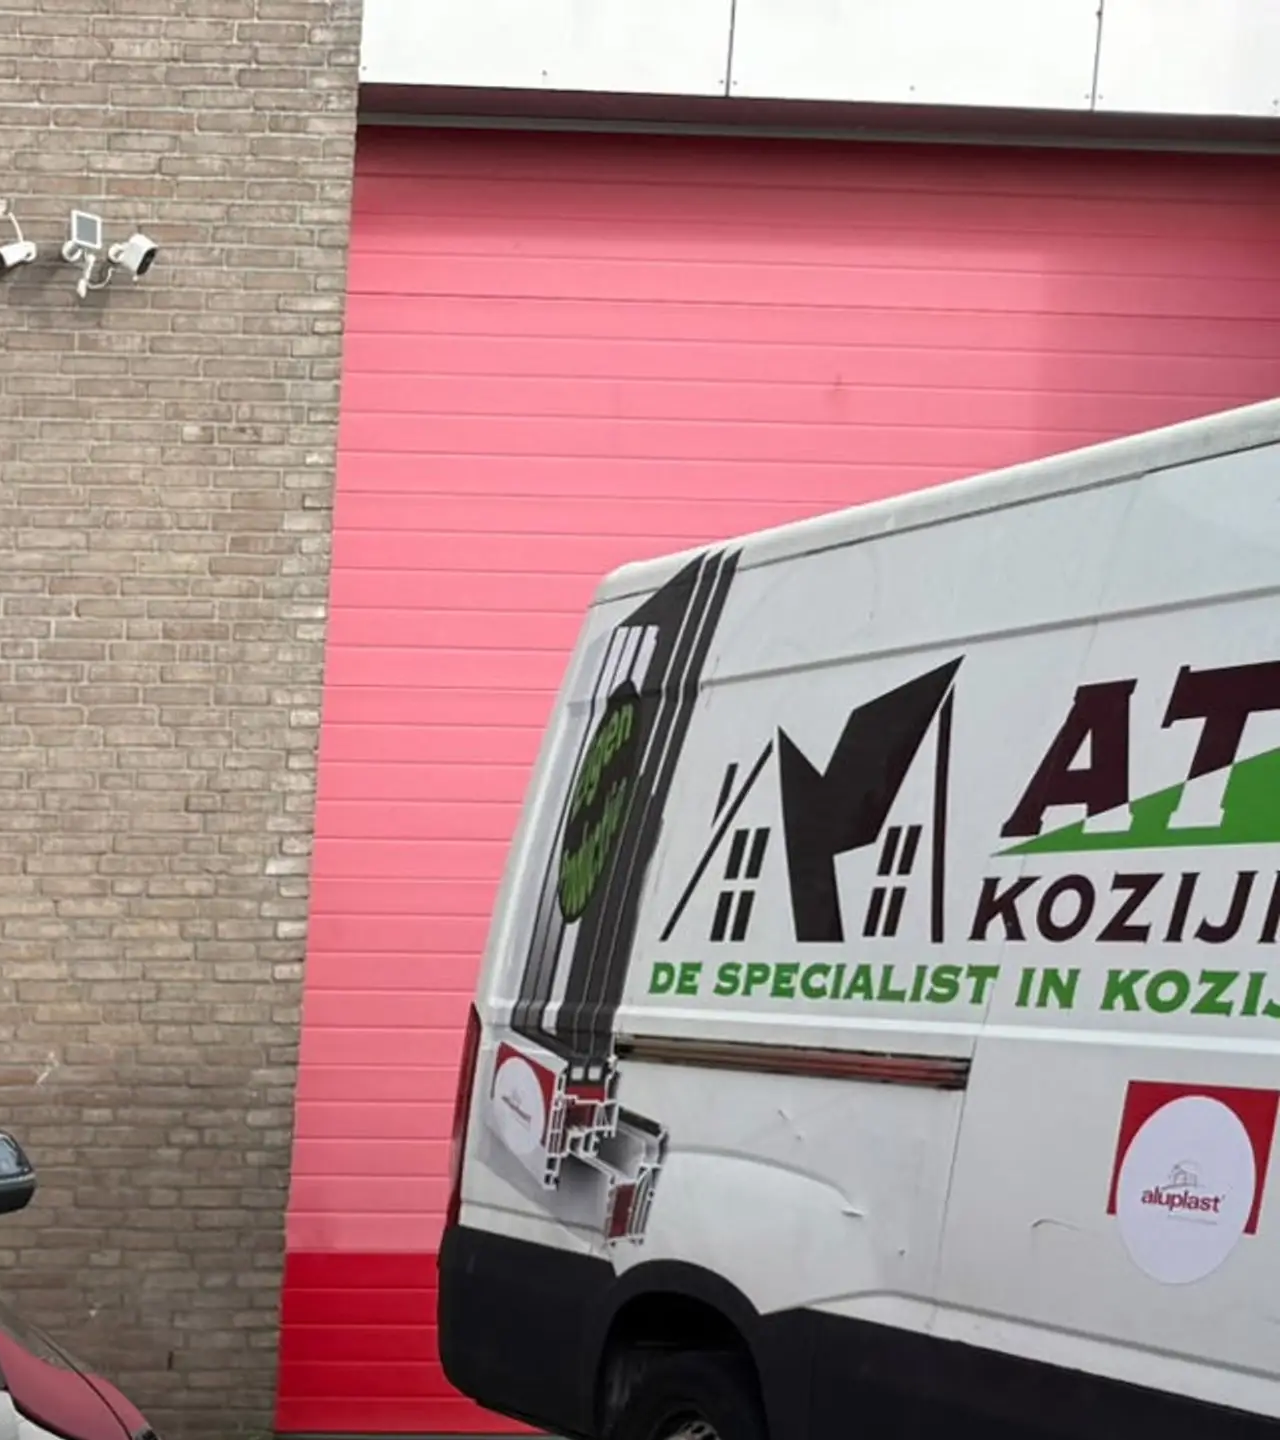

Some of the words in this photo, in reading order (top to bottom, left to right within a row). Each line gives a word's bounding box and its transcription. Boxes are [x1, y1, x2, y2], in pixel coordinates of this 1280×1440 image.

[647, 962, 703, 996] DE
[712, 962, 1000, 1005] SPECIALIST
[1014, 967, 1081, 1010] IN
[1141, 1186, 1221, 1213] aluplast
